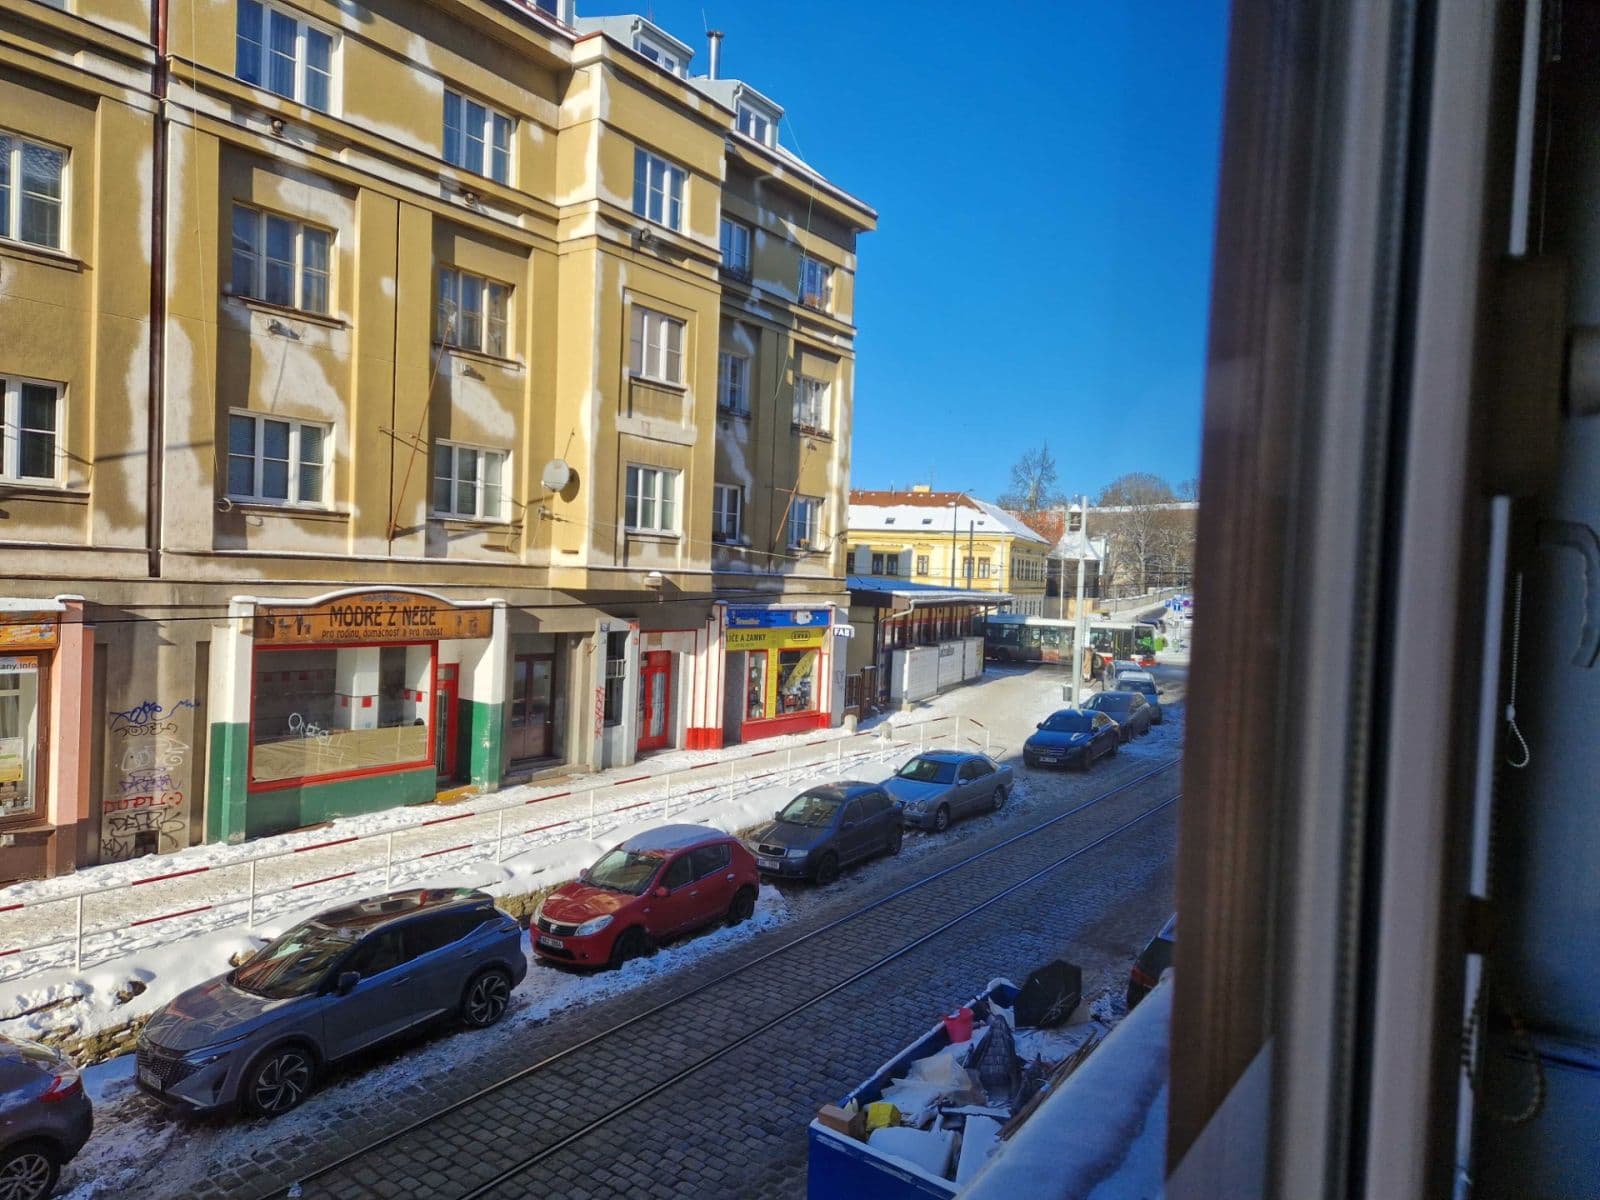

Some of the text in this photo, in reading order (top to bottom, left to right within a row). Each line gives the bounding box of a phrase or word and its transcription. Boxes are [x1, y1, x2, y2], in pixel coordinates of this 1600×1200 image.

[329, 602, 437, 627] MODRÉ Z NEBE
